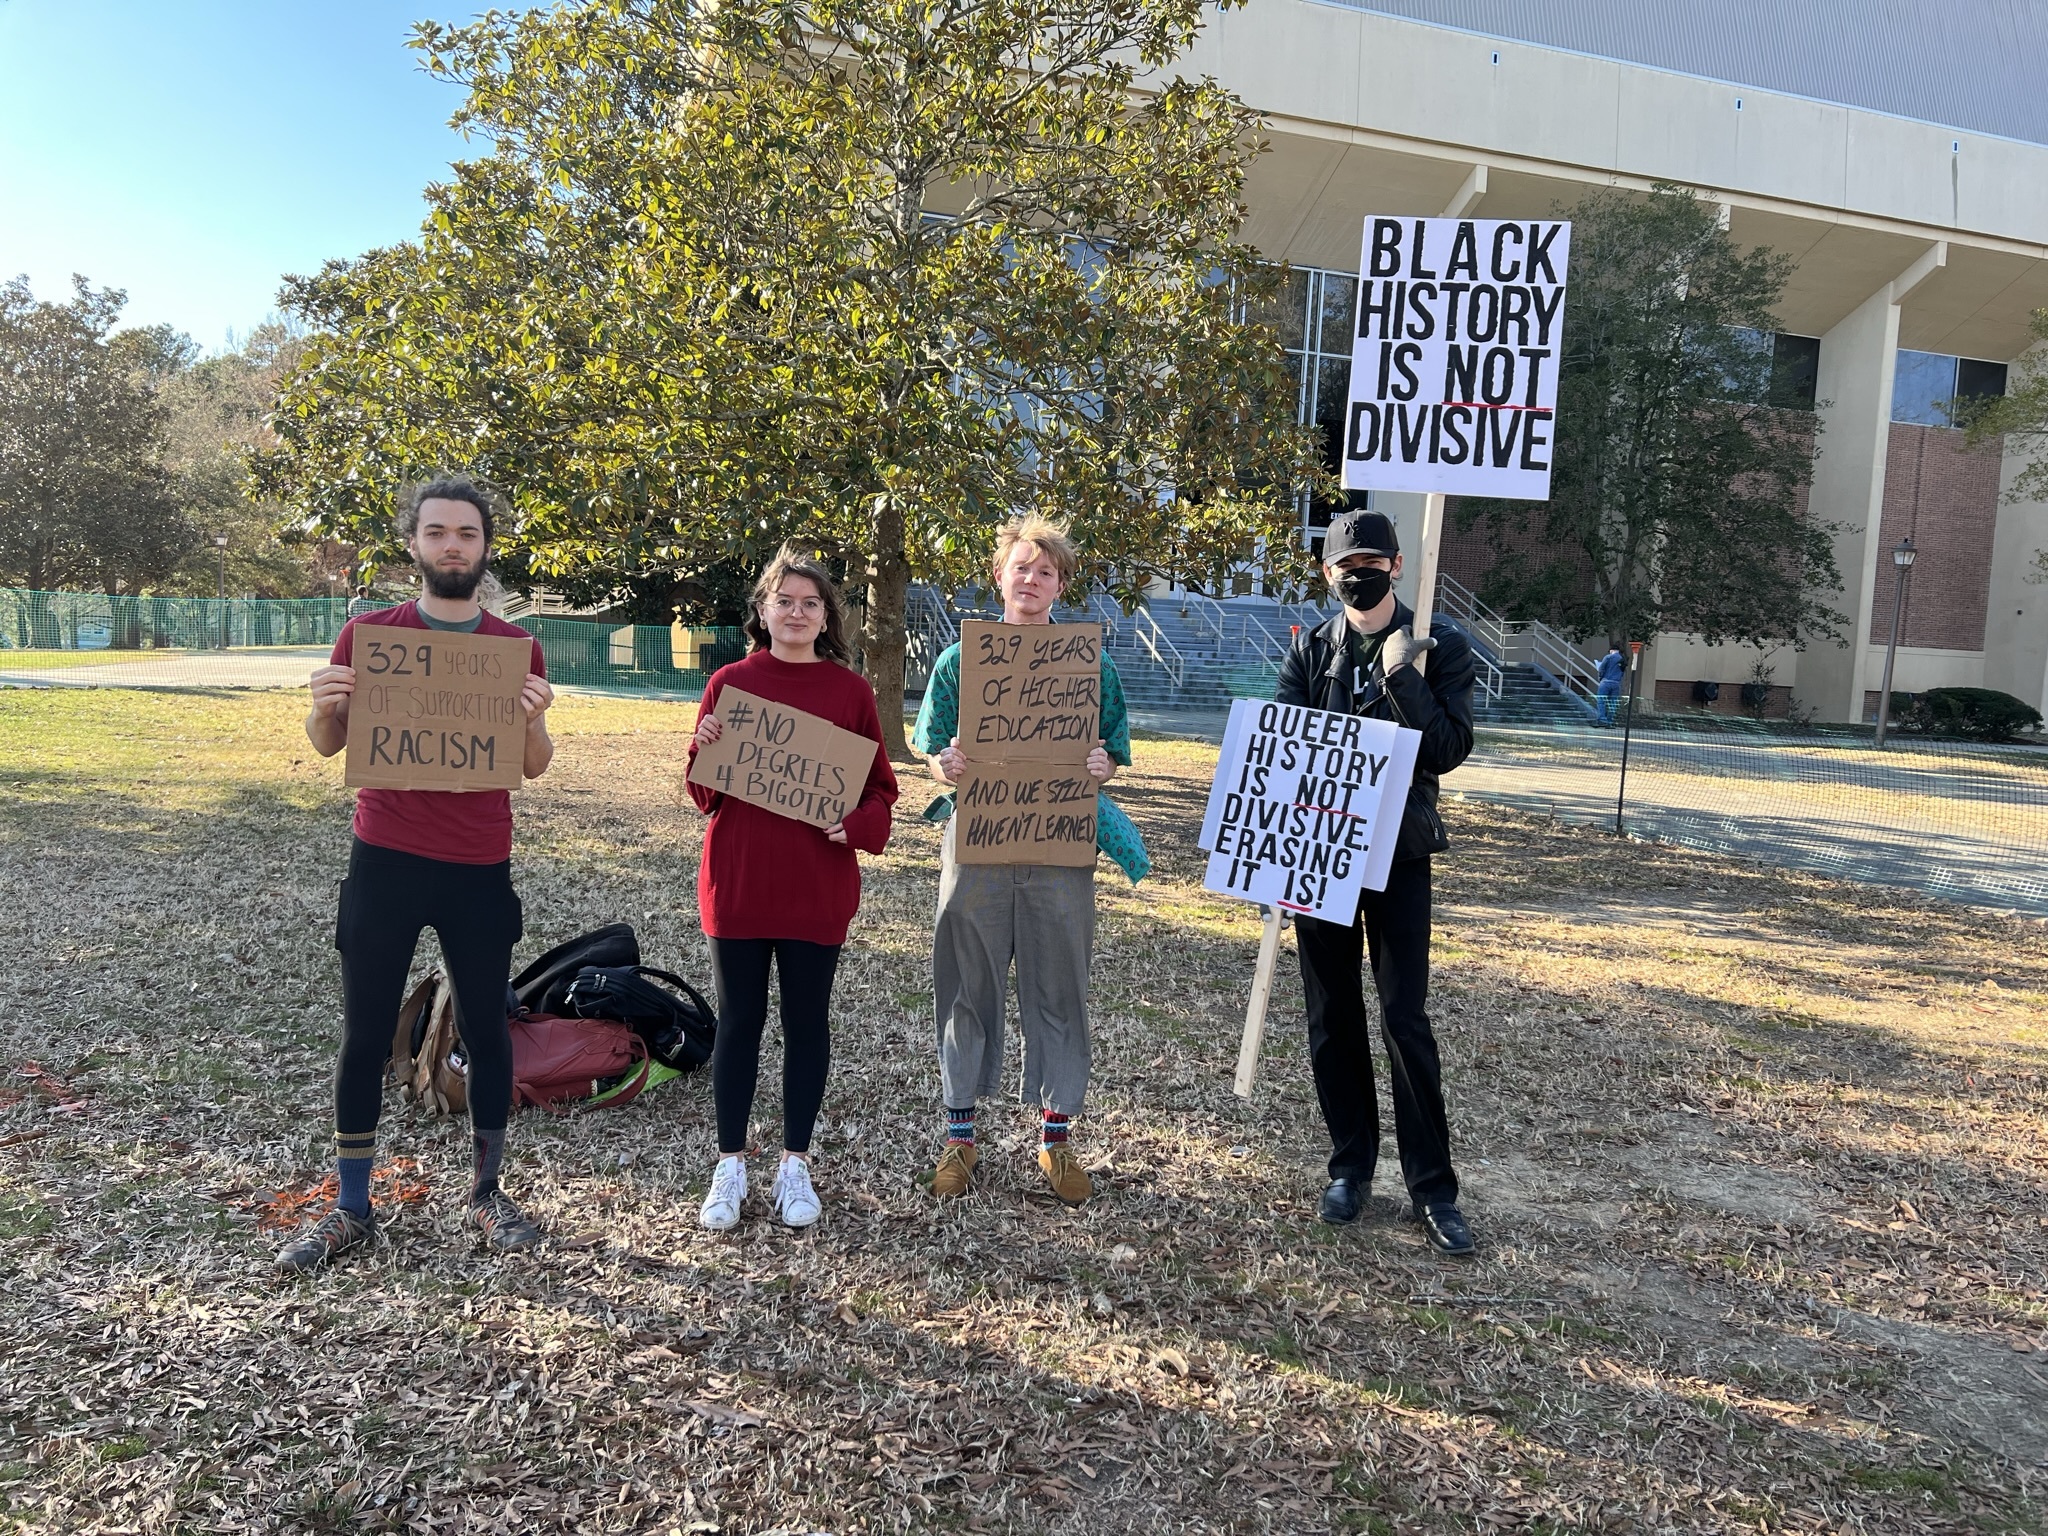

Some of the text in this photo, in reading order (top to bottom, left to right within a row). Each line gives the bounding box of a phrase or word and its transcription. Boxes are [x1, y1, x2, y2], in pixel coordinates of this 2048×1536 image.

[1370, 219, 1562, 283] BLACK
[1358, 280, 1564, 346] HISTORY
[1377, 342, 1550, 407] IS NOT
[1346, 402, 1552, 470] DIVISIVE
[367, 642, 431, 676] 329
[979, 634, 1096, 670] 329 YEARS
[368, 685, 400, 715] OF
[983, 676, 1099, 709] OF HIGHER
[370, 726, 495, 771] RACISM
[976, 713, 1095, 744] EDUCATION
[1259, 704, 1361, 749] QUEER
[736, 742, 845, 795] DEGREES
[1246, 734, 1389, 786] HISTORY
[716, 765, 845, 825] 4 BIGOTRY
[964, 777, 1094, 807] AND WE STILL
[1239, 765, 1360, 814] IS NOT
[966, 811, 1096, 849] HAVEN'T LEARNED
[1222, 793, 1369, 851] DIVISIVE.
[1215, 824, 1352, 879] ERASING
[1227, 859, 1328, 909] IT IS!
